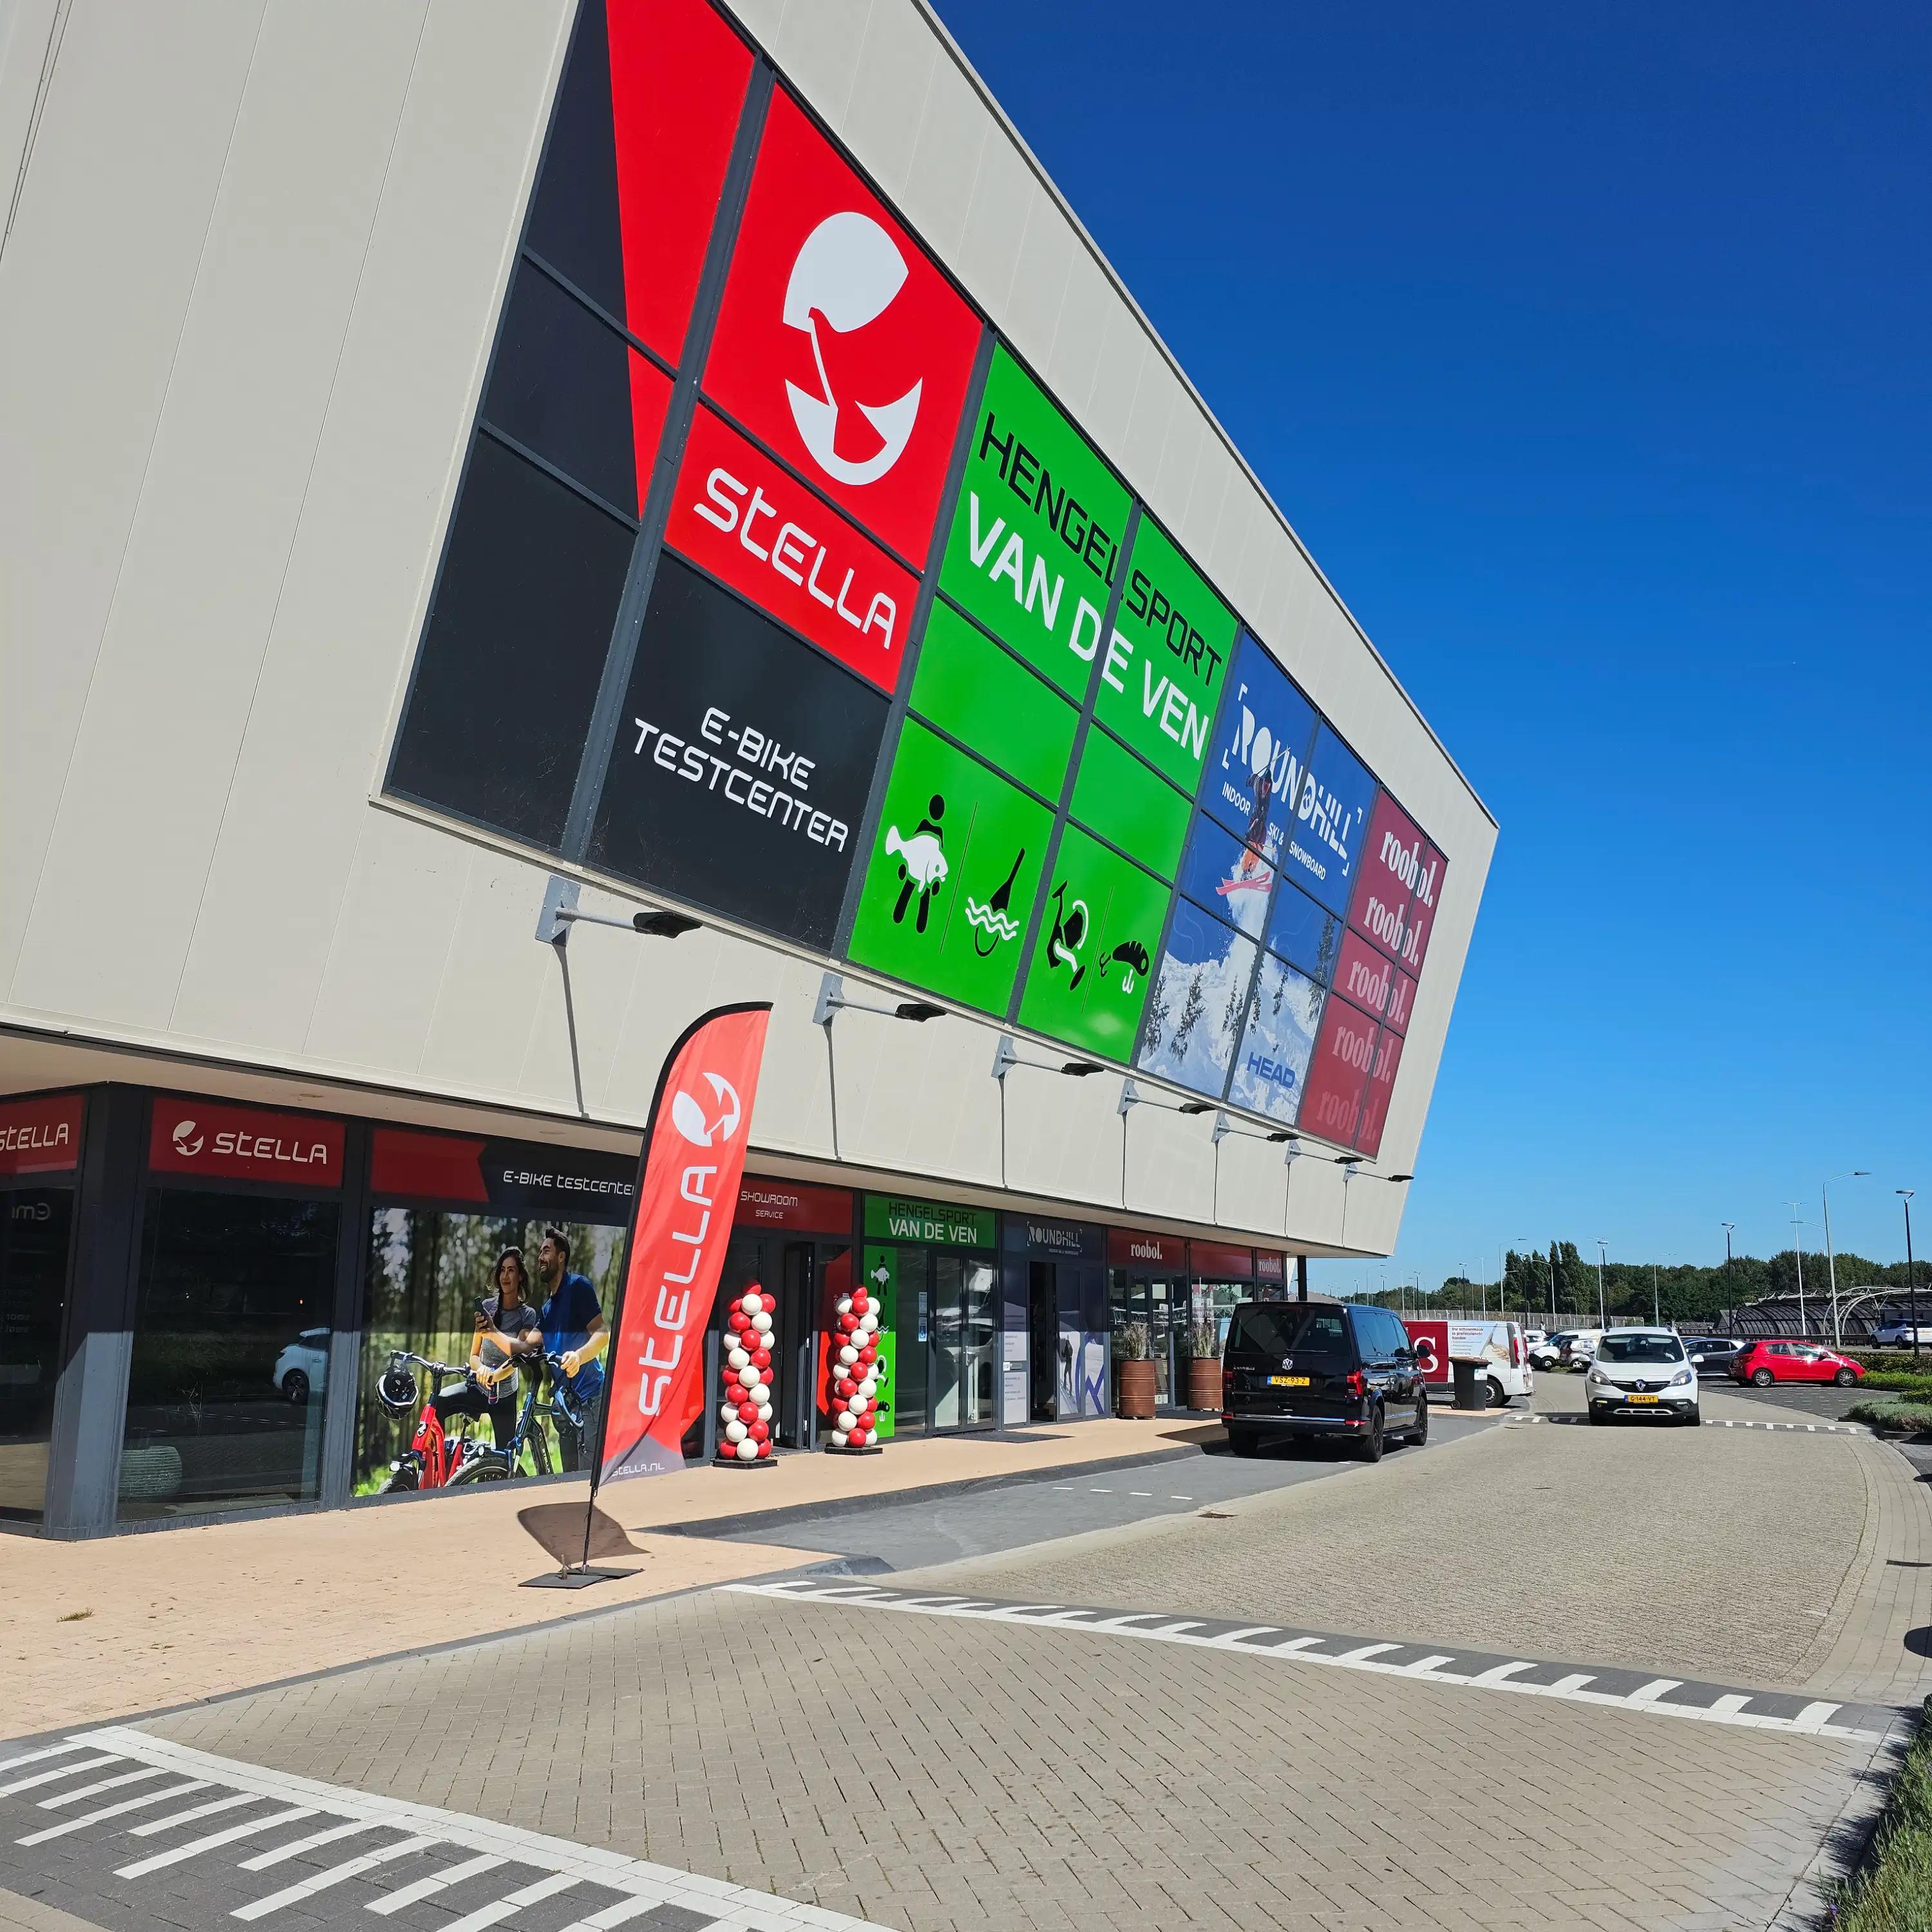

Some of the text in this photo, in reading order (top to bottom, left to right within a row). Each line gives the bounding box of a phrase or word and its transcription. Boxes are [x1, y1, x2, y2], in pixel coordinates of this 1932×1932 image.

[979, 412, 1222, 687] HENGELSPORT
[970, 491, 1209, 760] VAN DE VEN
[701, 707, 815, 790] E-BIKE
[634, 719, 848, 852] TESTCENTER
[1232, 705, 1350, 860] ROUNDHILL
[1222, 781, 1251, 816] INDOOR
[1267, 822, 1278, 842] SKI
[1289, 840, 1326, 880] SNOWBOARD
[1379, 831, 1437, 907] roobol.
[1363, 896, 1423, 966] roobol.
[1347, 961, 1408, 1025] roobol.
[1247, 1052, 1296, 1088] HEAD
[503, 1170, 553, 1187] E-BIKE
[740, 1190, 798, 1206] SHOWROOM
[755, 1209, 784, 1219] SERVICE
[889, 1201, 977, 1226] HENGELSPORT
[889, 1218, 977, 1244] VAN DE VEN
[1028, 1226, 1081, 1247] ROUNDHILL
[1130, 1240, 1162, 1260] roobol.
[1258, 1257, 1281, 1273] roobol.
